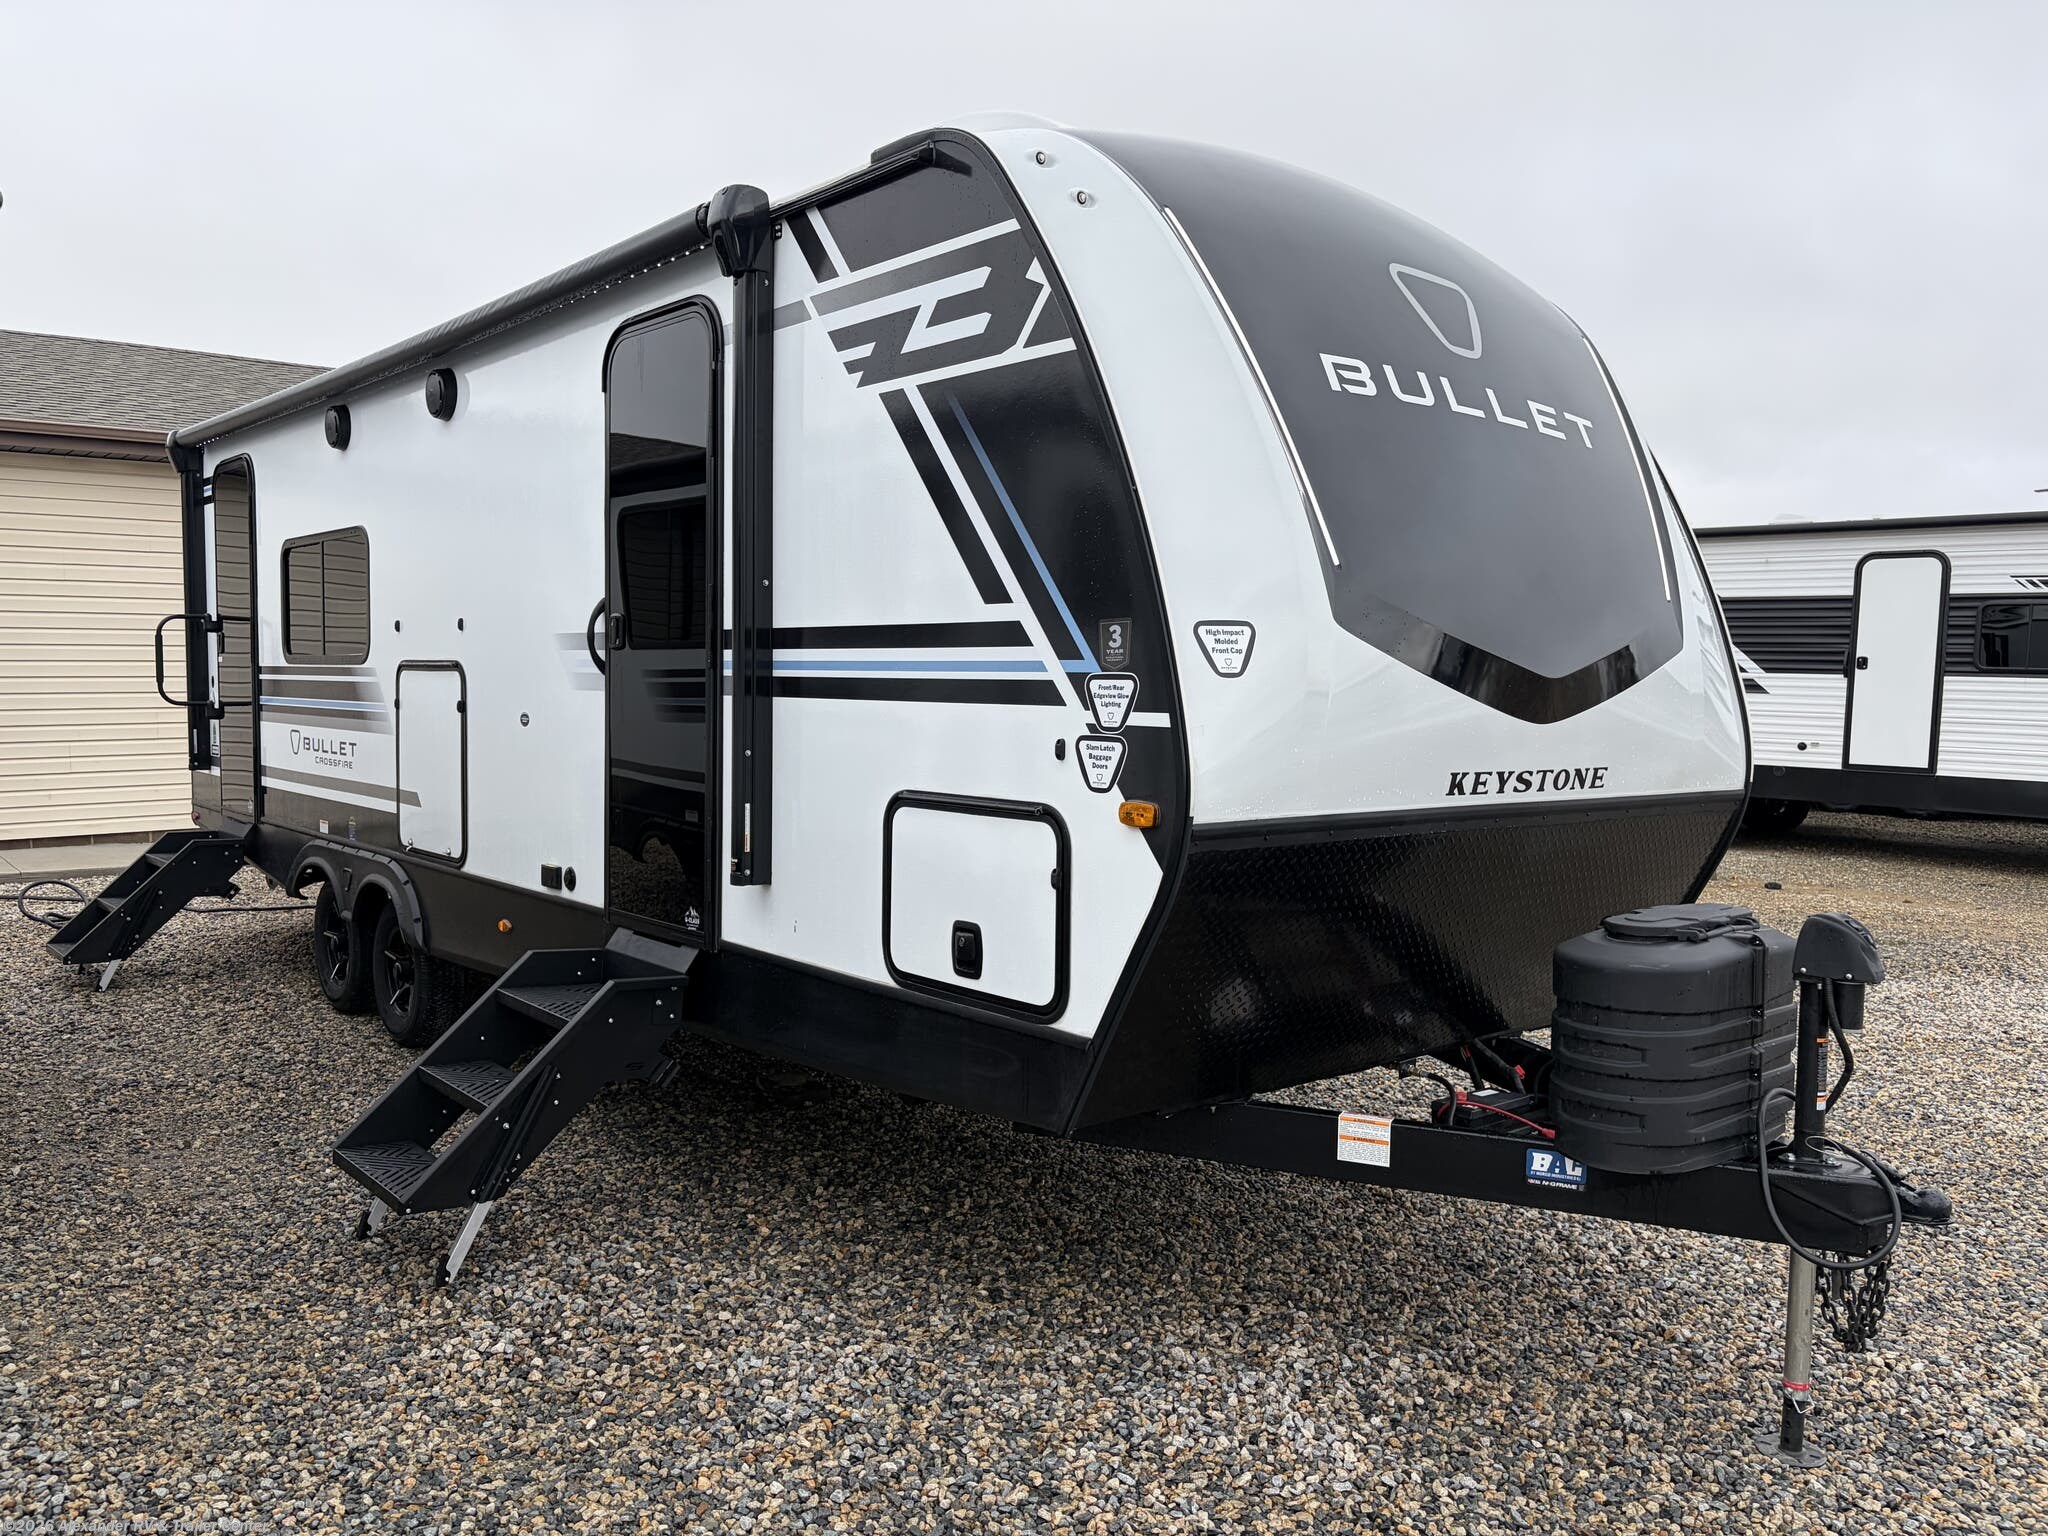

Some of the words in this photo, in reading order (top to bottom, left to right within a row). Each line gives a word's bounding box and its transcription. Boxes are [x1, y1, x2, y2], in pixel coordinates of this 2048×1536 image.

[1319, 352, 1593, 448] BULLET
[1108, 624, 1122, 648] 3
[1230, 647, 1243, 655] Cap
[1100, 700, 1121, 708] Lighting
[303, 737, 357, 756] BULLET
[315, 756, 353, 769] CROSSFIRE
[1092, 762, 1108, 770] Doors
[1446, 766, 1608, 796] KEYSTONE
